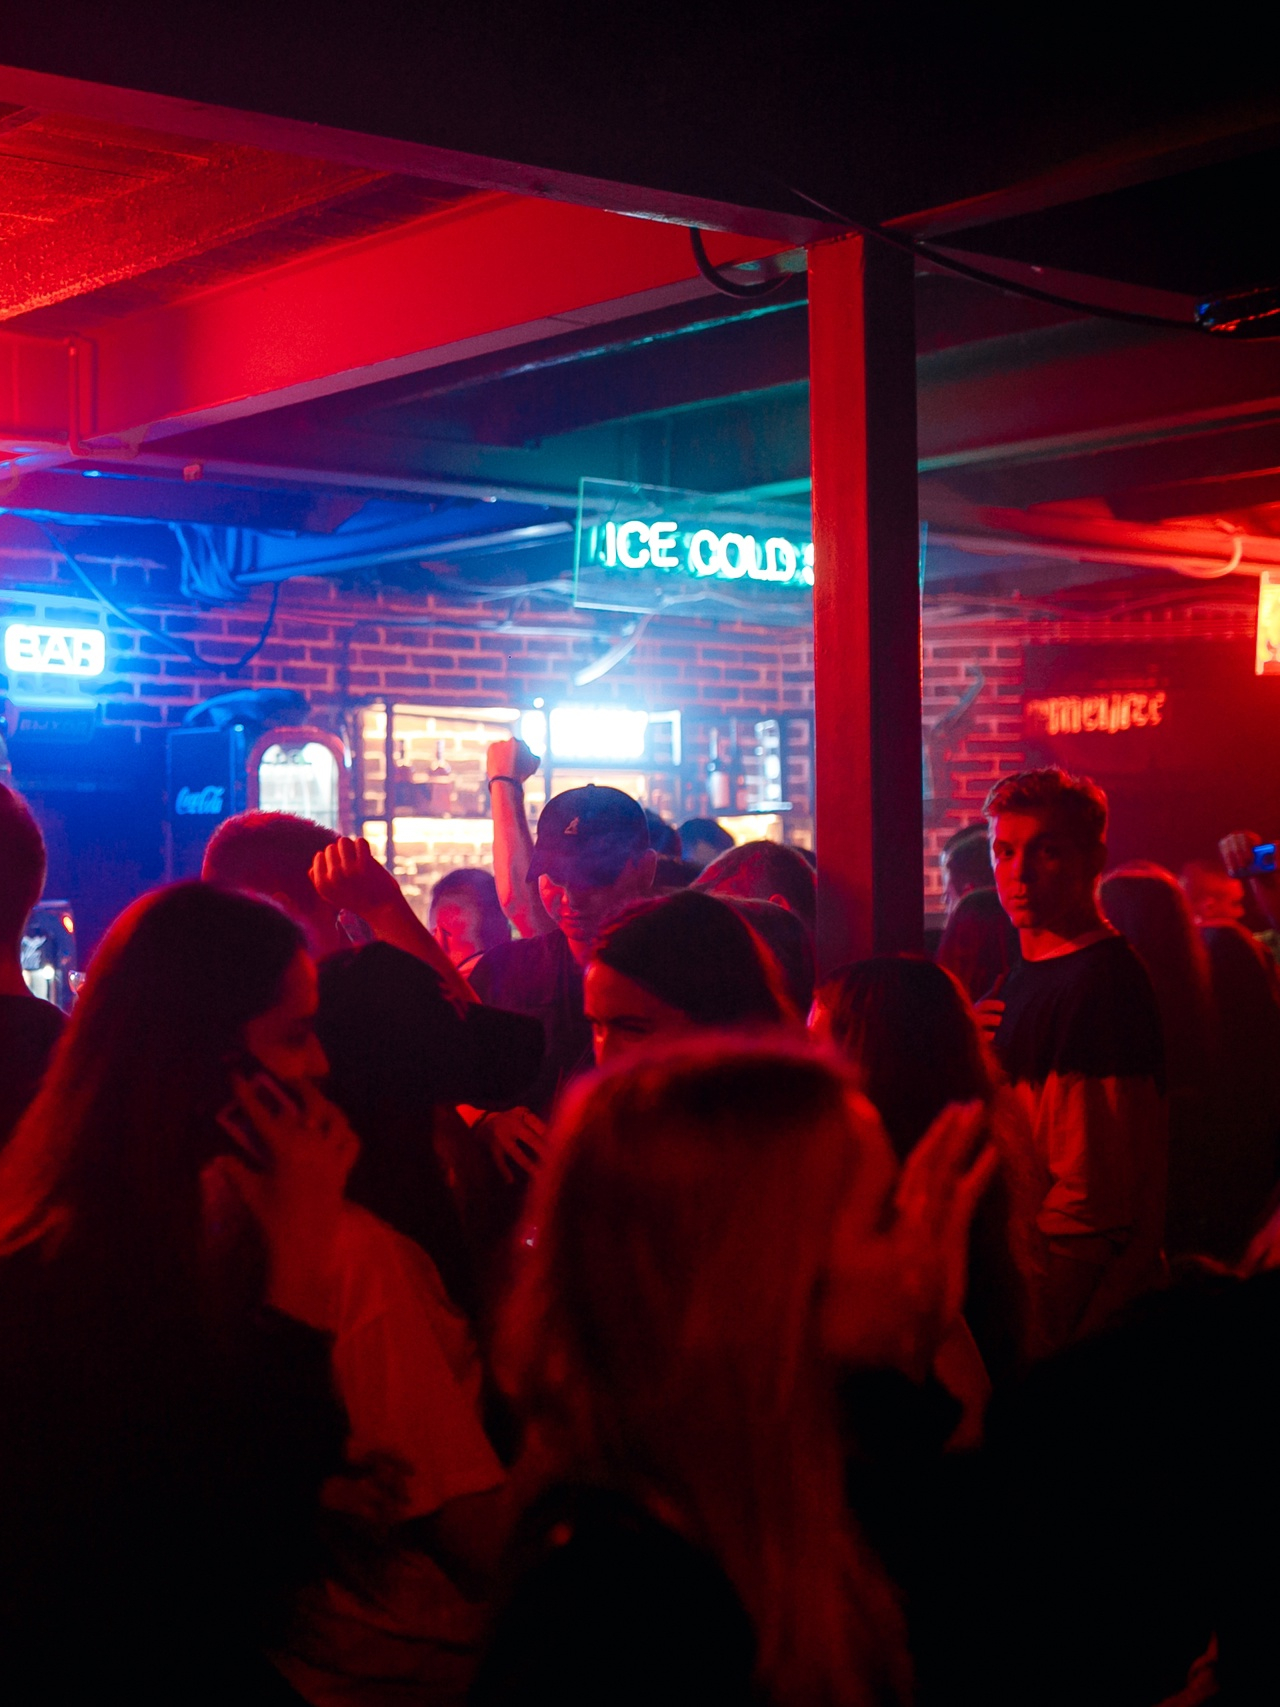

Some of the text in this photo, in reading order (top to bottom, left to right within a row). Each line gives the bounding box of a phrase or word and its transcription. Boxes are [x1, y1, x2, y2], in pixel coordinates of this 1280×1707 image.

[604, 520, 680, 569] ICE
[689, 528, 798, 582] COLD
[10, 630, 98, 671] BAR
